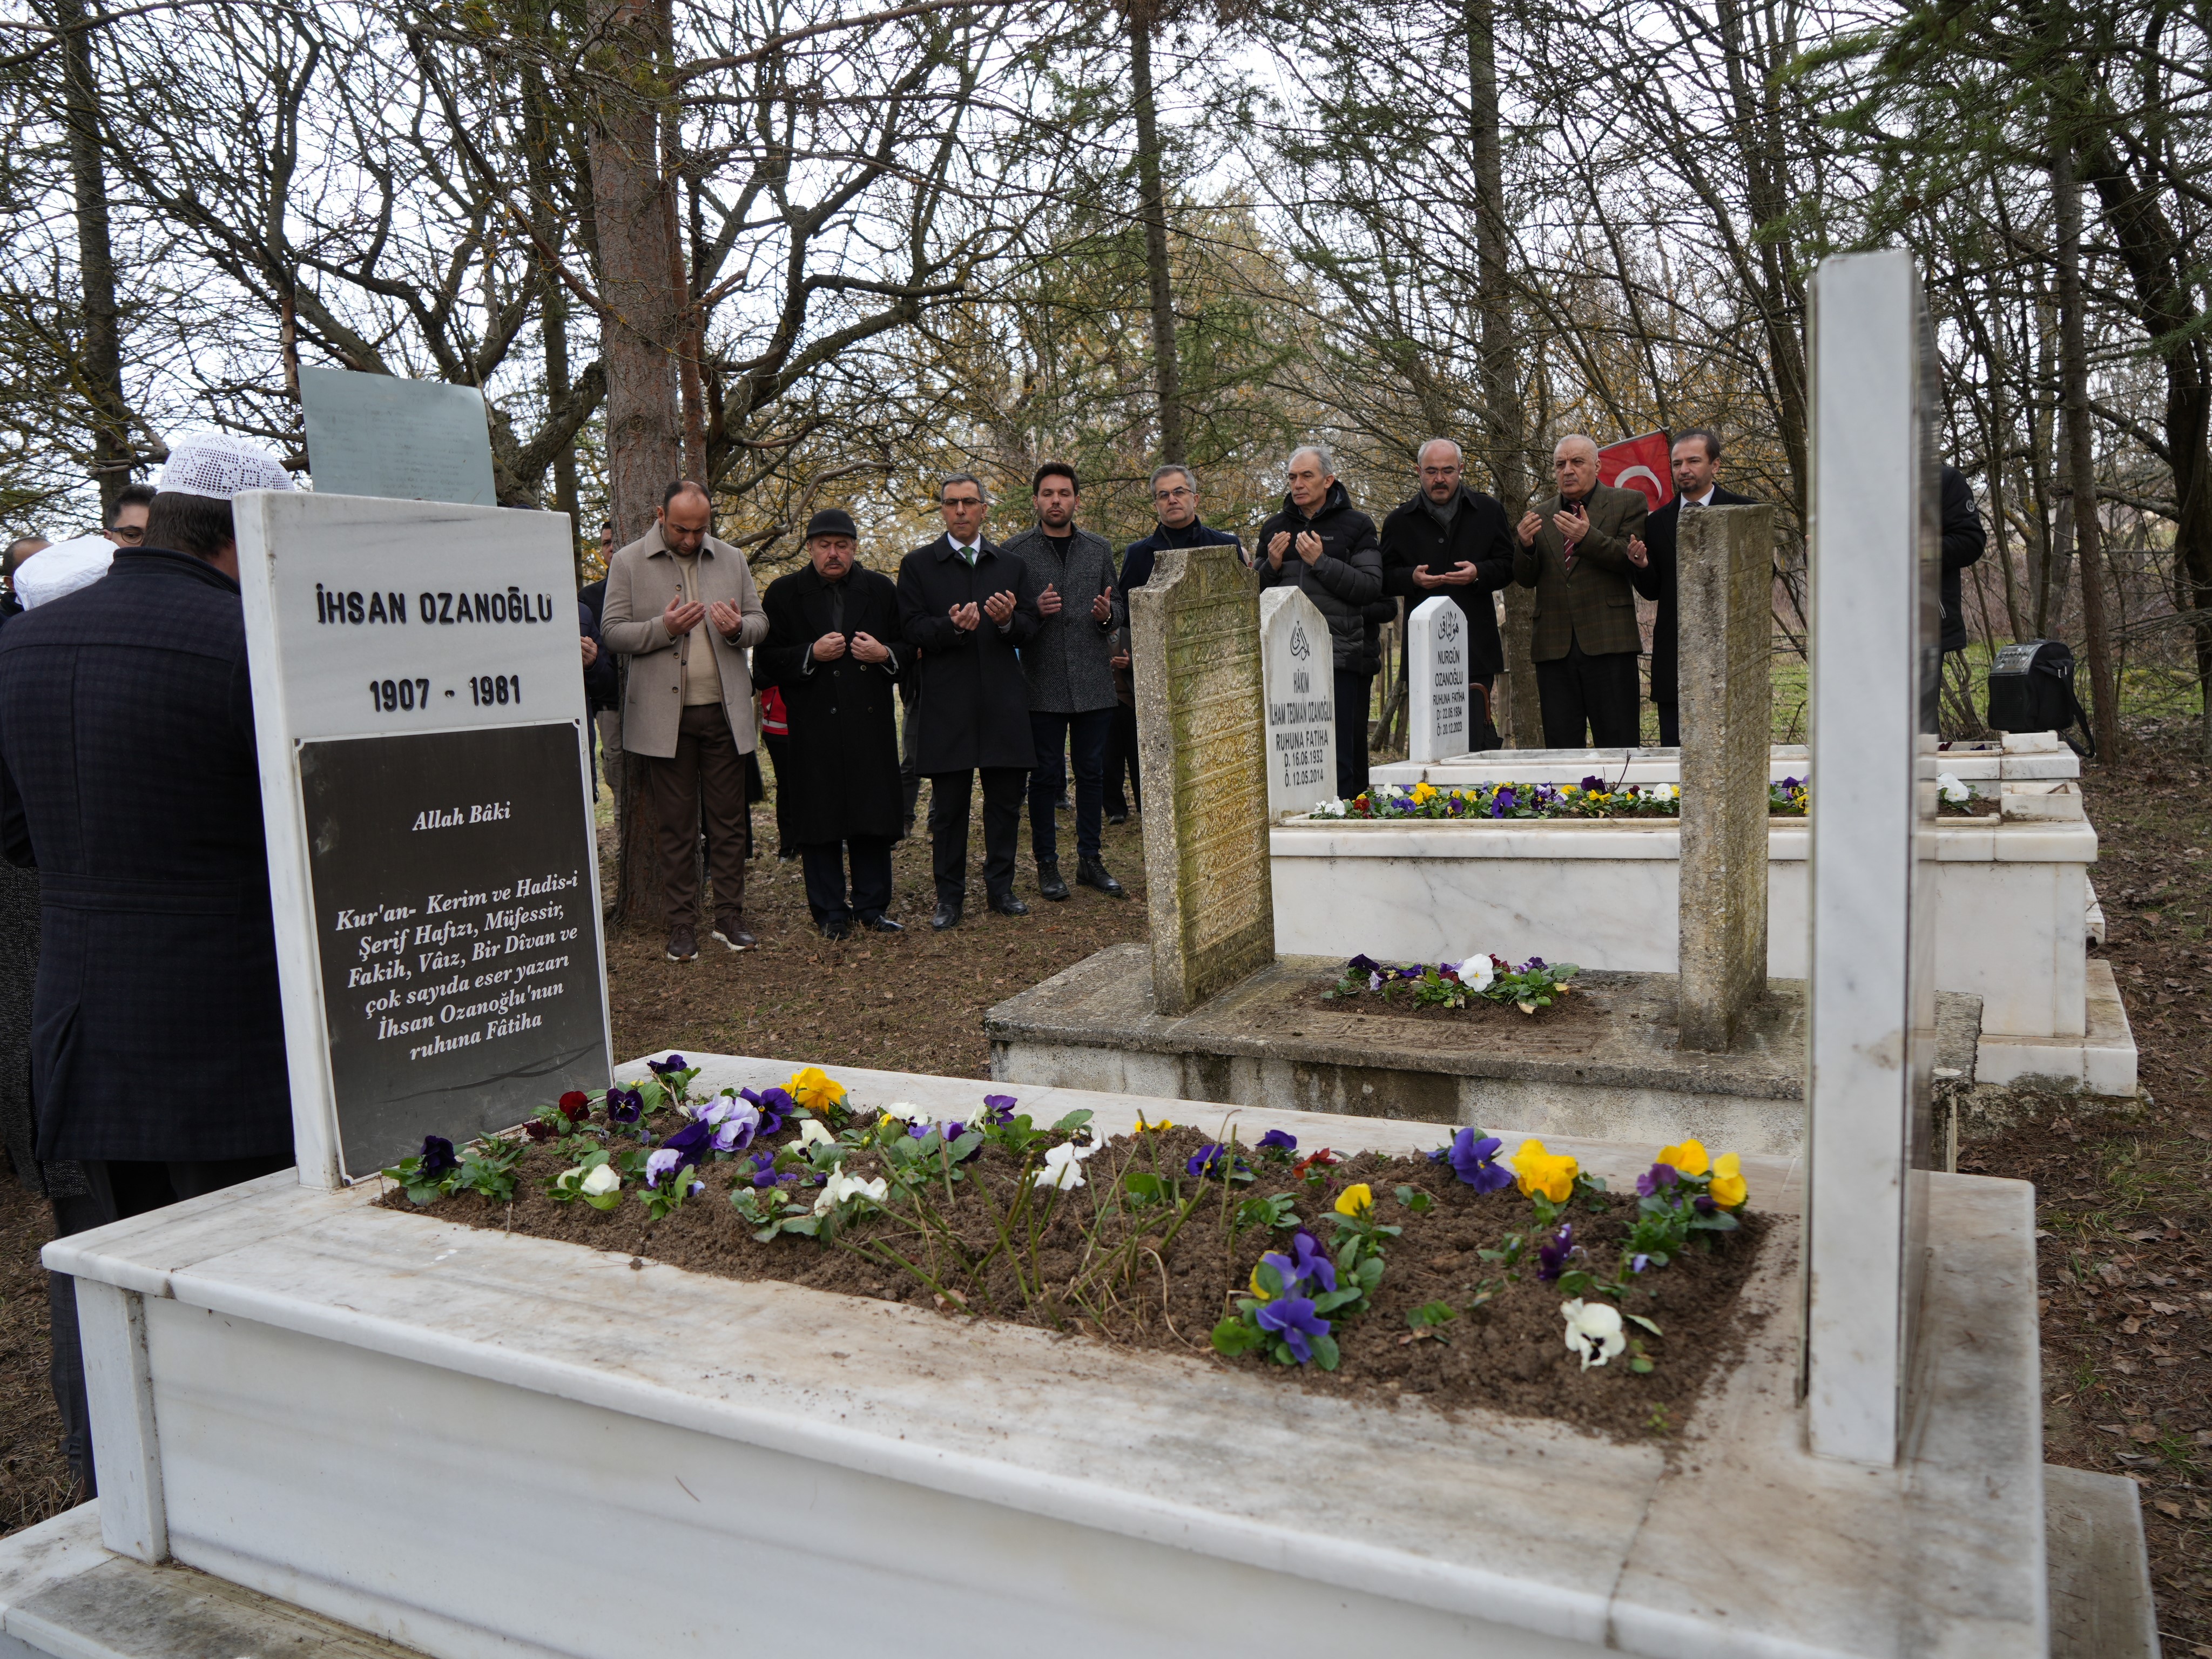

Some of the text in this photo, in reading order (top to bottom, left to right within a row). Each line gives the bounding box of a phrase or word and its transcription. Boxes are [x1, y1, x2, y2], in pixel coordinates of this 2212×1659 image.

[316, 583, 552, 625] İHSAN OZANOĞLU
[1438, 647, 1459, 665] NURGÜN
[1435, 668, 1463, 687] OZANOĞLU
[370, 679, 430, 712] 1907
[469, 675, 521, 706] 1981
[1433, 689, 1465, 706] RUHUNA FATİHA
[1270, 695, 1332, 726] İLHAM TEOMAN OZANOĞLU
[1437, 709, 1442, 720] D:
[1276, 725, 1328, 751] RUHUNA FATİHA
[1442, 721, 1462, 735] 20.12.2023
[1284, 748, 1323, 767] D. 16.06.1932
[1285, 768, 1324, 787] Ö. 12.05.2014
[412, 801, 511, 831] Allah Bâki
[335, 871, 578, 930] Kur'an- Kerim ve Hadis-i
[359, 902, 564, 960] Şerif Hafızı, Müfessir,
[348, 926, 577, 987] Fakih, Vâız, Bir Dîvan ve
[366, 954, 570, 1019] çok sayıda eser yazarı
[378, 982, 564, 1040] İhsan Ozanoğlu'nun
[410, 1013, 542, 1060] ruhuna Fâtiha
